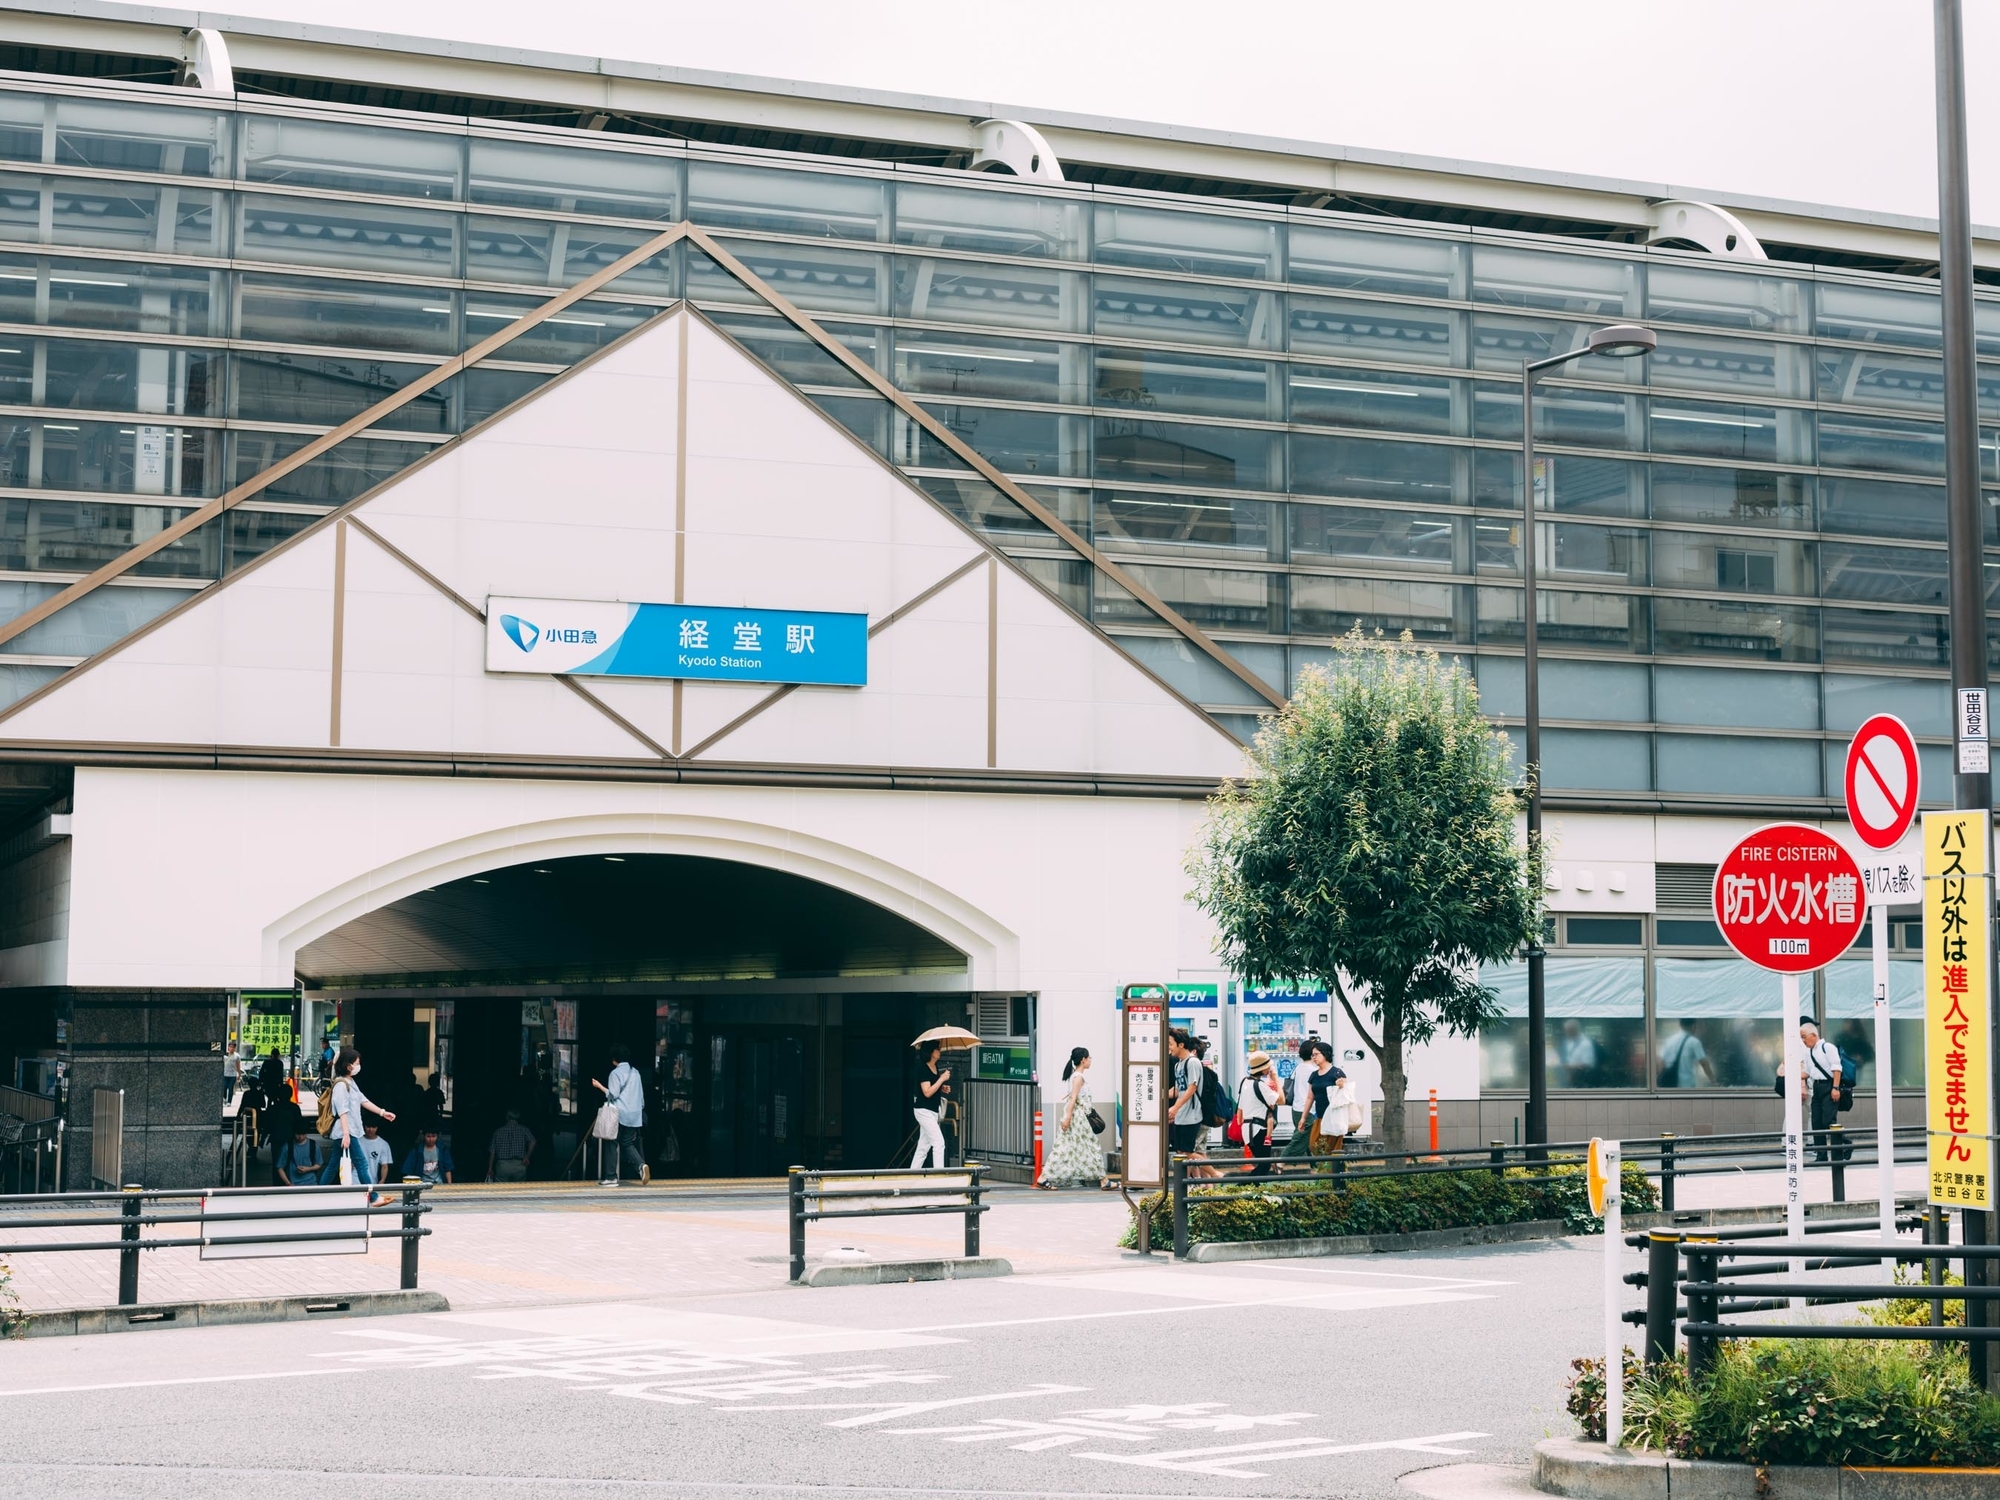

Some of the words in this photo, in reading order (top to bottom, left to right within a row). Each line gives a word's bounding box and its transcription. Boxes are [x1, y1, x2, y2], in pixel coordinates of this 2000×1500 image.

[545, 628, 598, 644] 小田急
[678, 618, 816, 655] 経堂駅
[678, 654, 717, 668] Kyodo
[720, 656, 762, 669] Station
[1966, 692, 1982, 735] 世田谷区
[1741, 847, 1772, 861] FIRE
[1777, 847, 1838, 861] CISTERN
[1723, 872, 1858, 926] 防火水槽
[1168, 990, 1187, 1002] TO
[1187, 990, 1207, 1002] EN
[1297, 986, 1316, 997] EN
[1941, 820, 1971, 1163] バス以外は進入できません
[1787, 1134, 1798, 1202] 東京消防庁
[1933, 1171, 1985, 1187] 北沢警察署
[1934, 1185, 1985, 1201] 世田谷区
